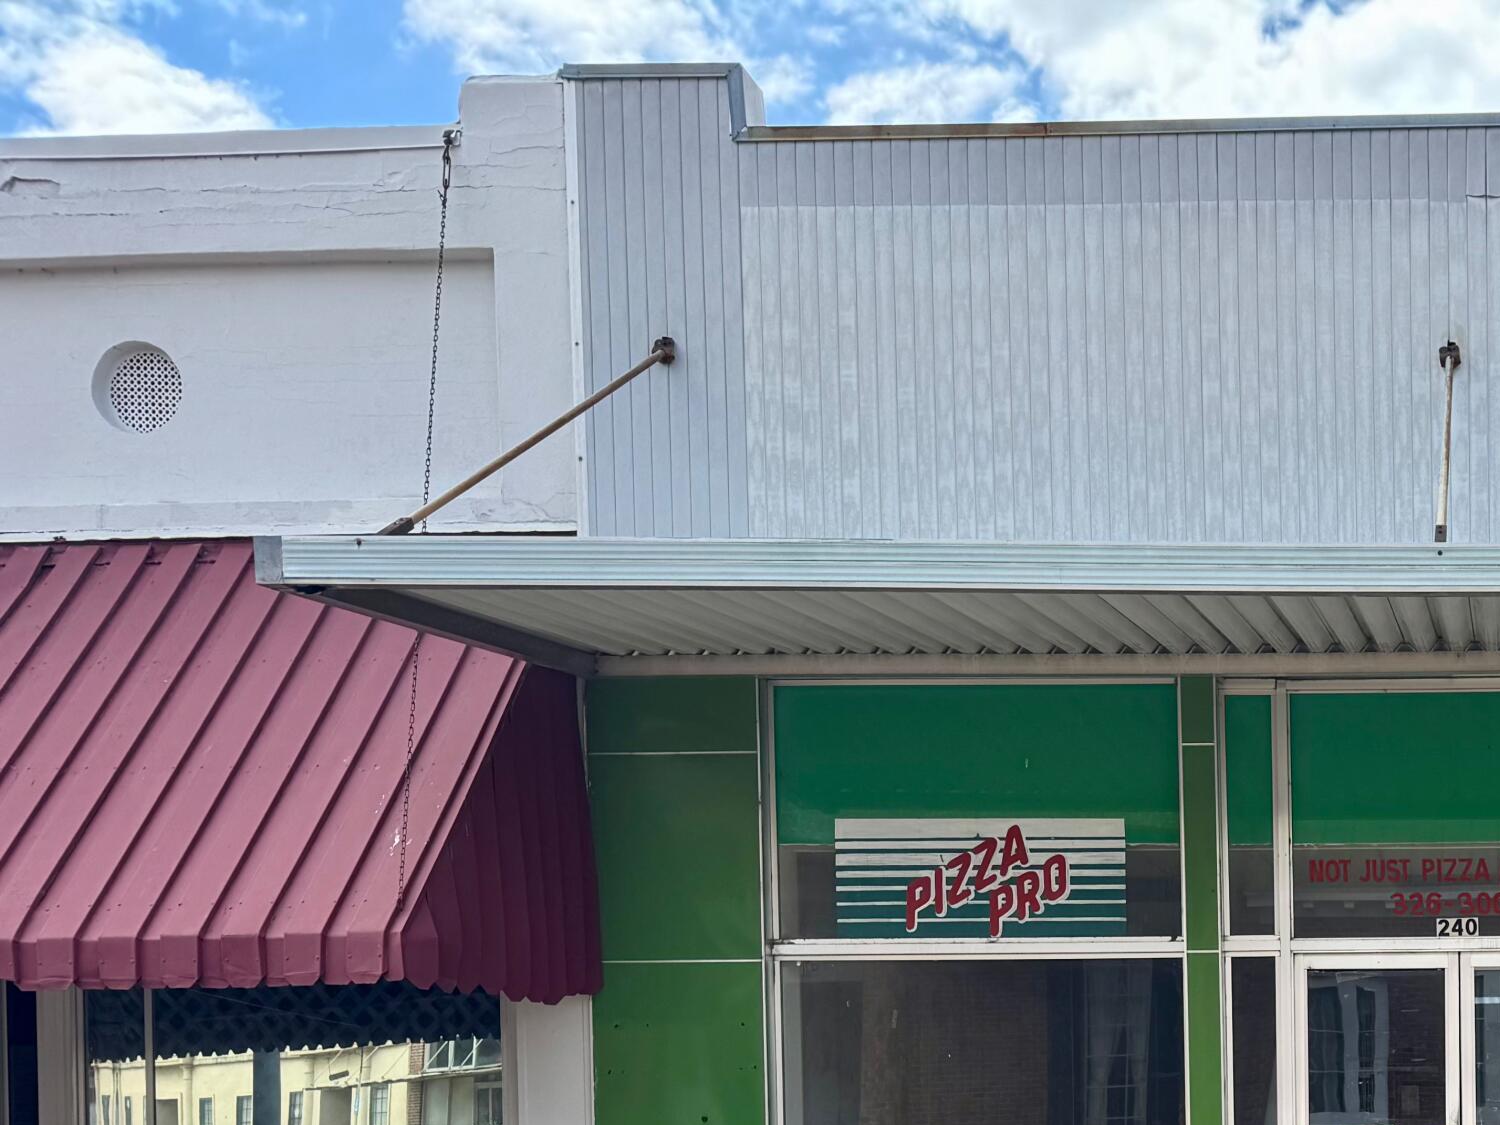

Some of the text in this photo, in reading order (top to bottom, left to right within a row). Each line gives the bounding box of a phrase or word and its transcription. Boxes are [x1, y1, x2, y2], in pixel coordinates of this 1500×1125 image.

[906, 823, 1030, 932] PIZZA
[989, 853, 1070, 938] PRO
[1308, 859, 1351, 883] NOT
[1359, 858, 1411, 883] JUST
[1421, 857, 1490, 882] PIZZA
[1437, 918, 1478, 937] 240
